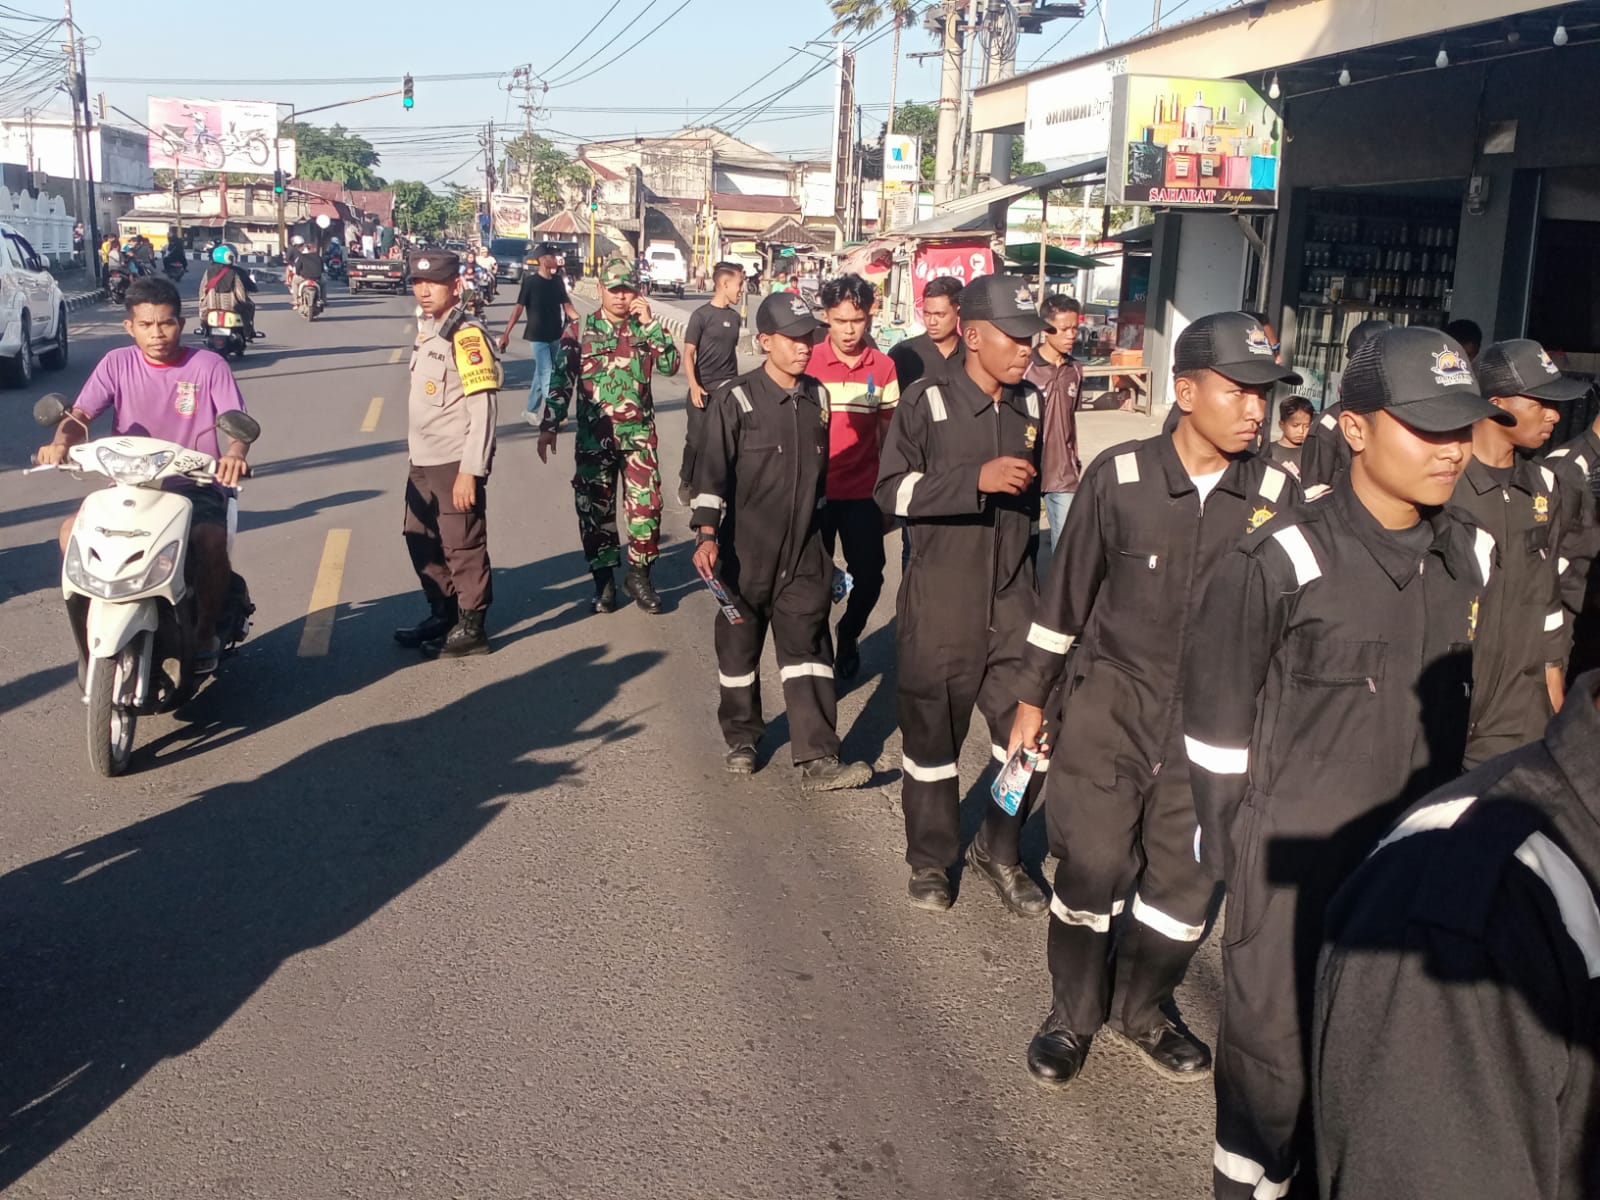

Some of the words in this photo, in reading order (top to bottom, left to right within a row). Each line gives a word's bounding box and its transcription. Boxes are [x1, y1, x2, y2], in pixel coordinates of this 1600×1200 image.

[1149, 187, 1216, 203] SAHABAT
[1220, 191, 1253, 206] Parfum
[428, 351, 445, 362] POLRI
